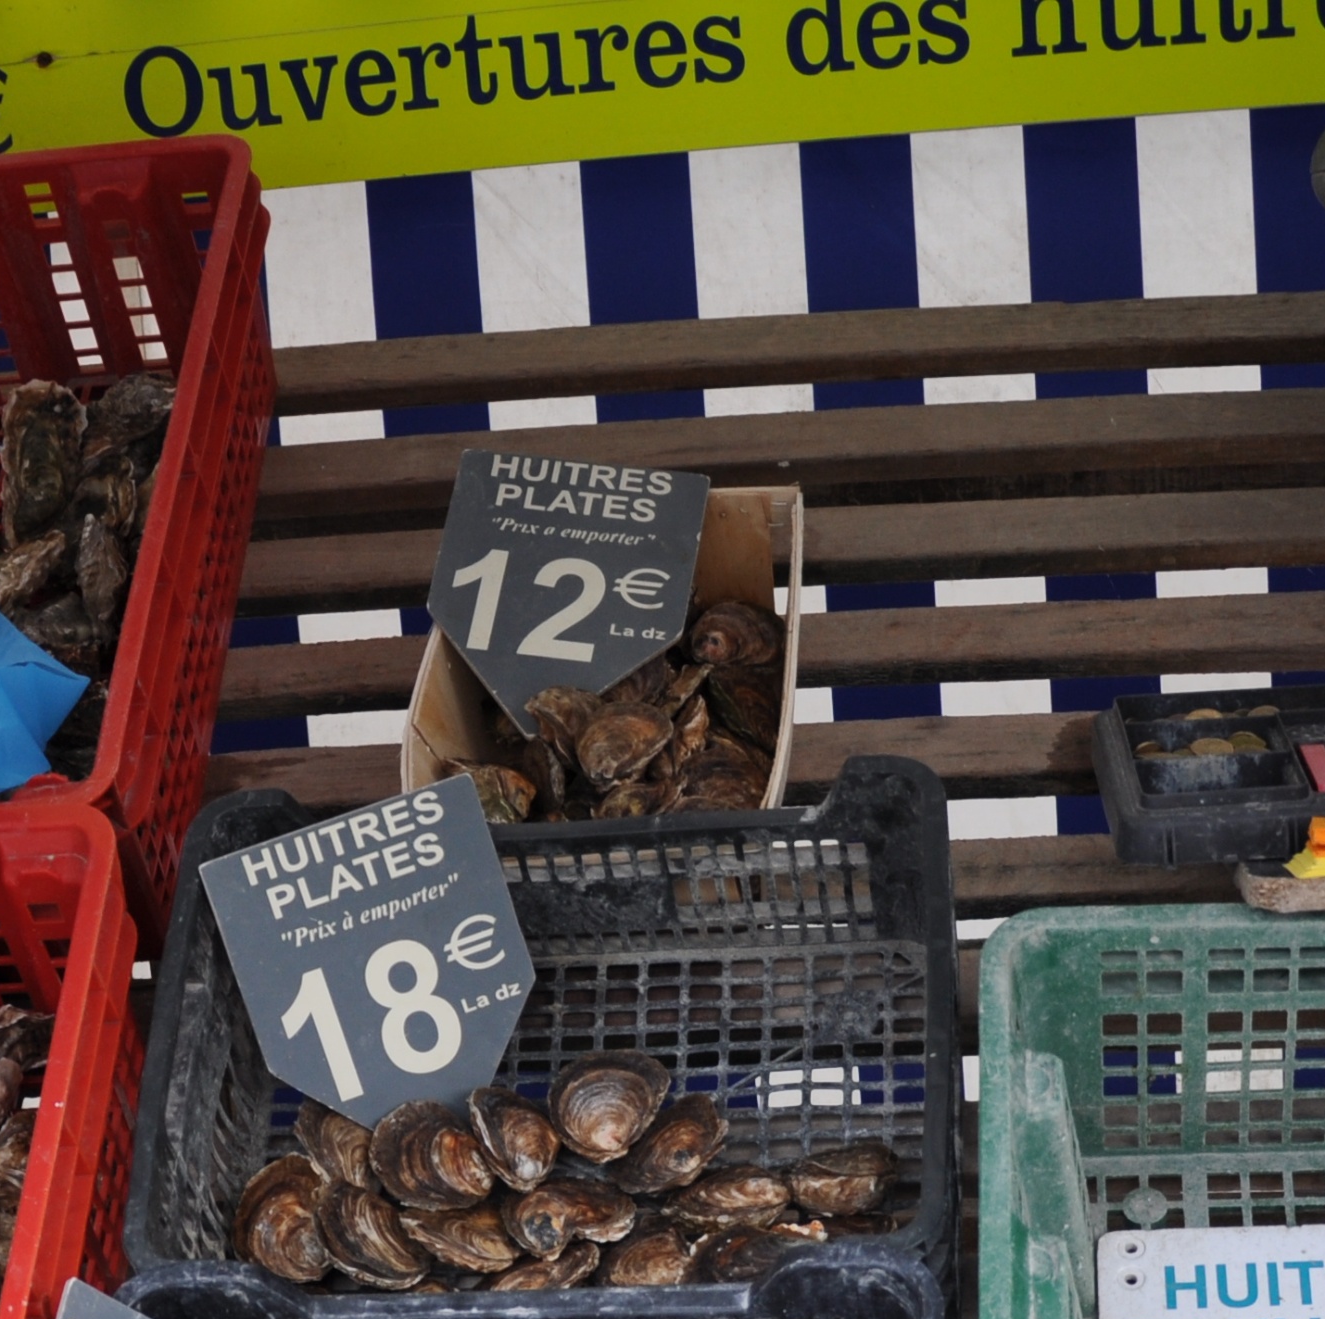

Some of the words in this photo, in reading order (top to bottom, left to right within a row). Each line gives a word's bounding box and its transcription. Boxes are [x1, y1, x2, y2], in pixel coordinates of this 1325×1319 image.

[123, 13, 745, 138] Ouvertures
[786, 0, 970, 76] des
[491, 453, 672, 495] HUITRES
[495, 483, 657, 523] PLATES
[609, 623, 635, 638] La
[641, 625, 666, 641] dz
[241, 791, 444, 887] HUITRES
[266, 832, 444, 920] PLATES
[343, 911, 354, 930] à
[461, 995, 489, 1014] La
[495, 982, 521, 1001] dz
